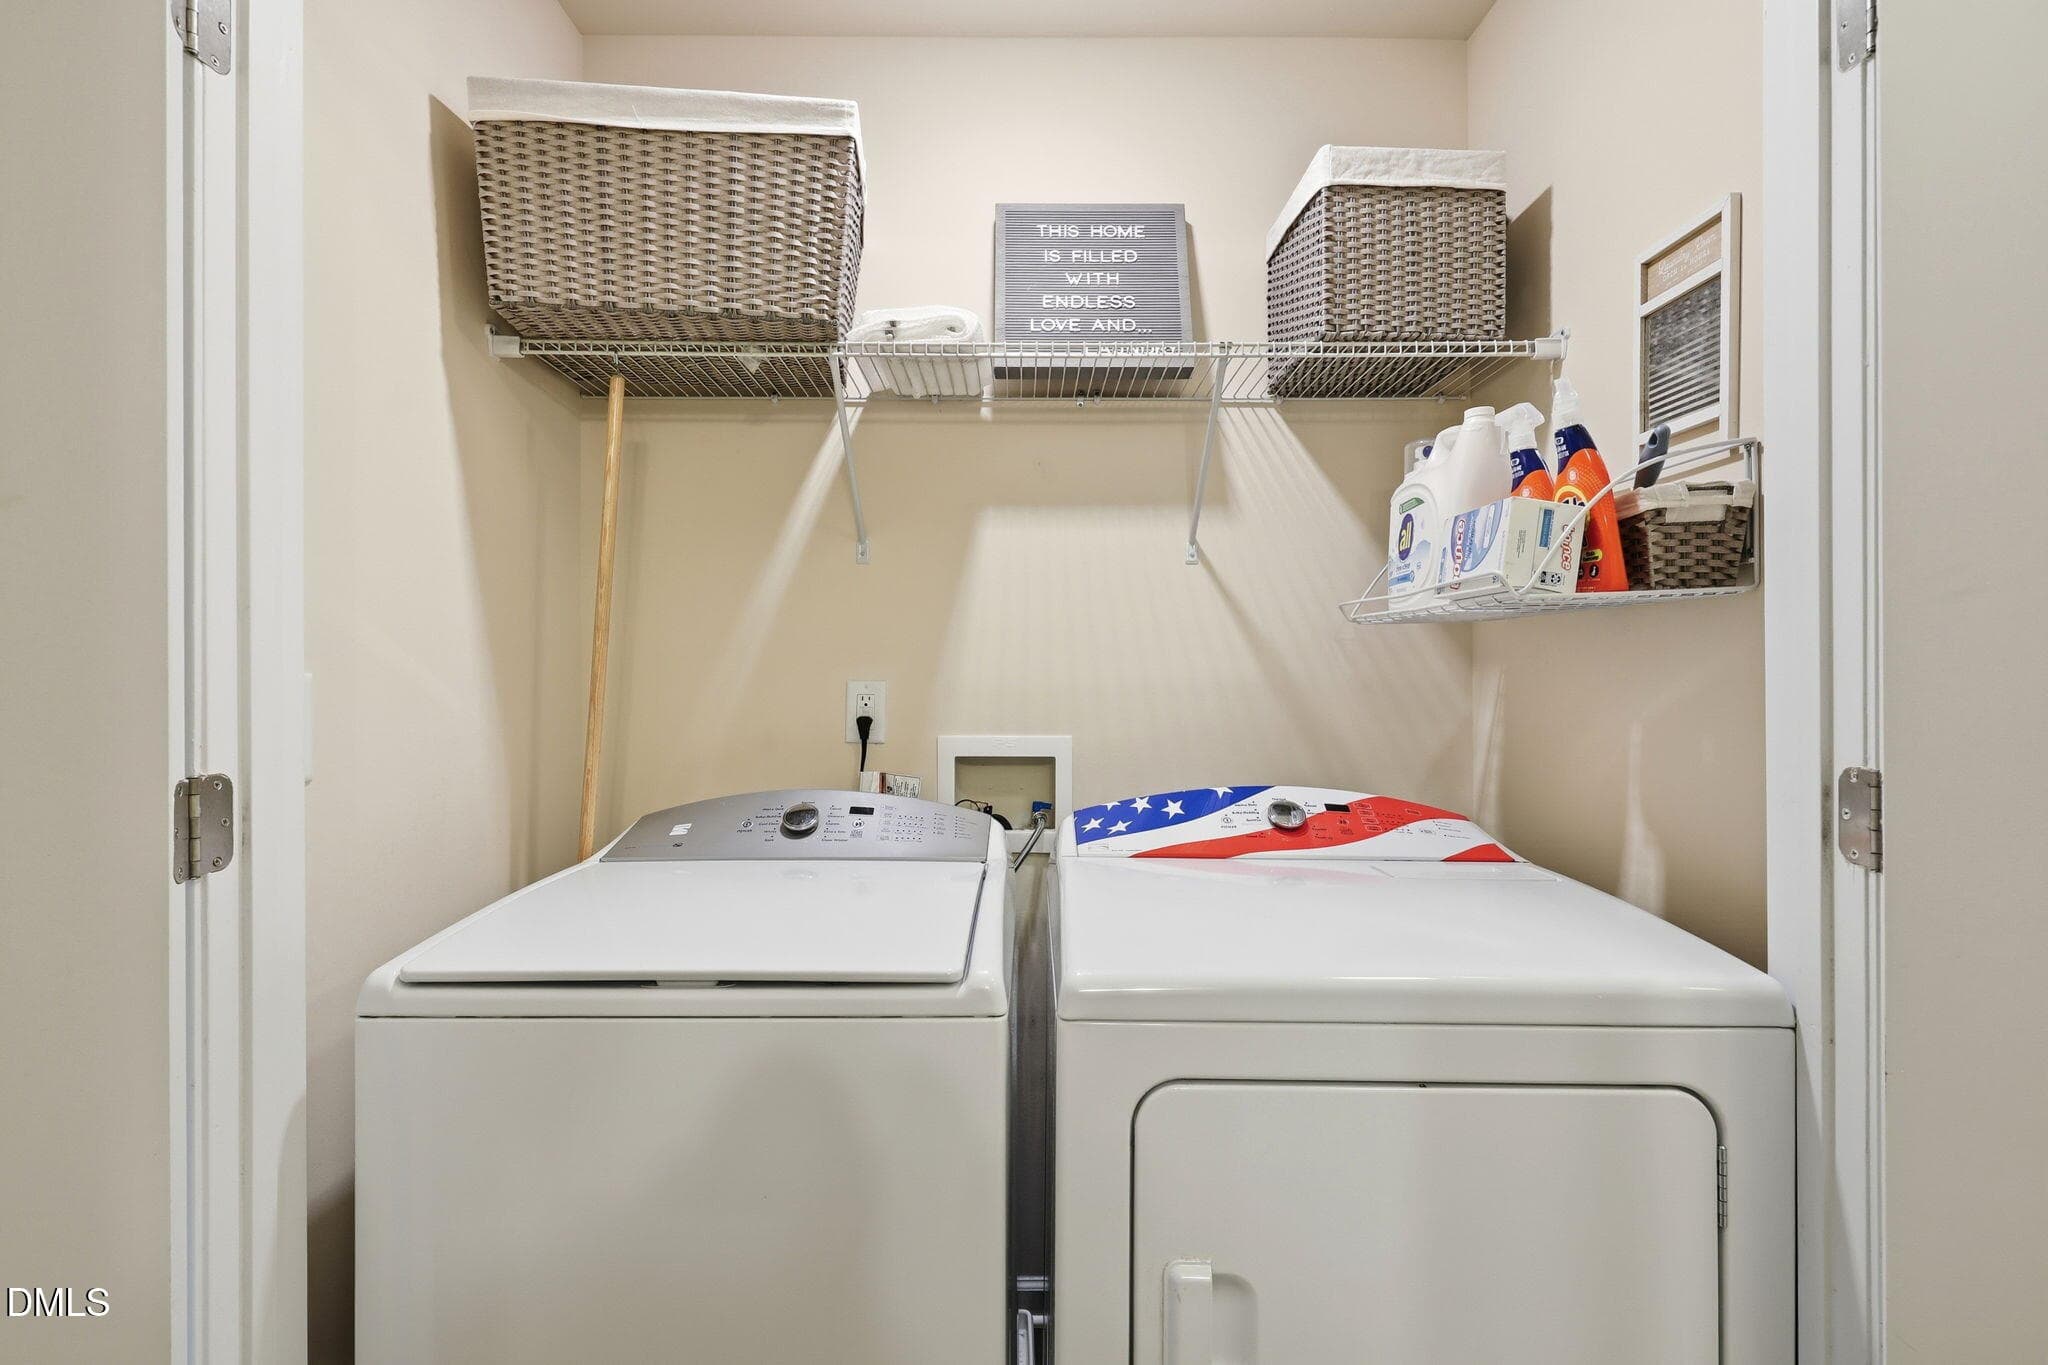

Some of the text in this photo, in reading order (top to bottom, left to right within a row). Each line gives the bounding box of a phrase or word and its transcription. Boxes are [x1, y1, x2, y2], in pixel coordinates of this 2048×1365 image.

[1036, 224, 1146, 239] THIS HOME
[1044, 250, 1139, 264] IS FILLED
[1065, 272, 1120, 286] WITH
[1042, 295, 1136, 309] ENDLESS
[1030, 318, 1081, 332] LOVE
[1399, 521, 1412, 551] all
